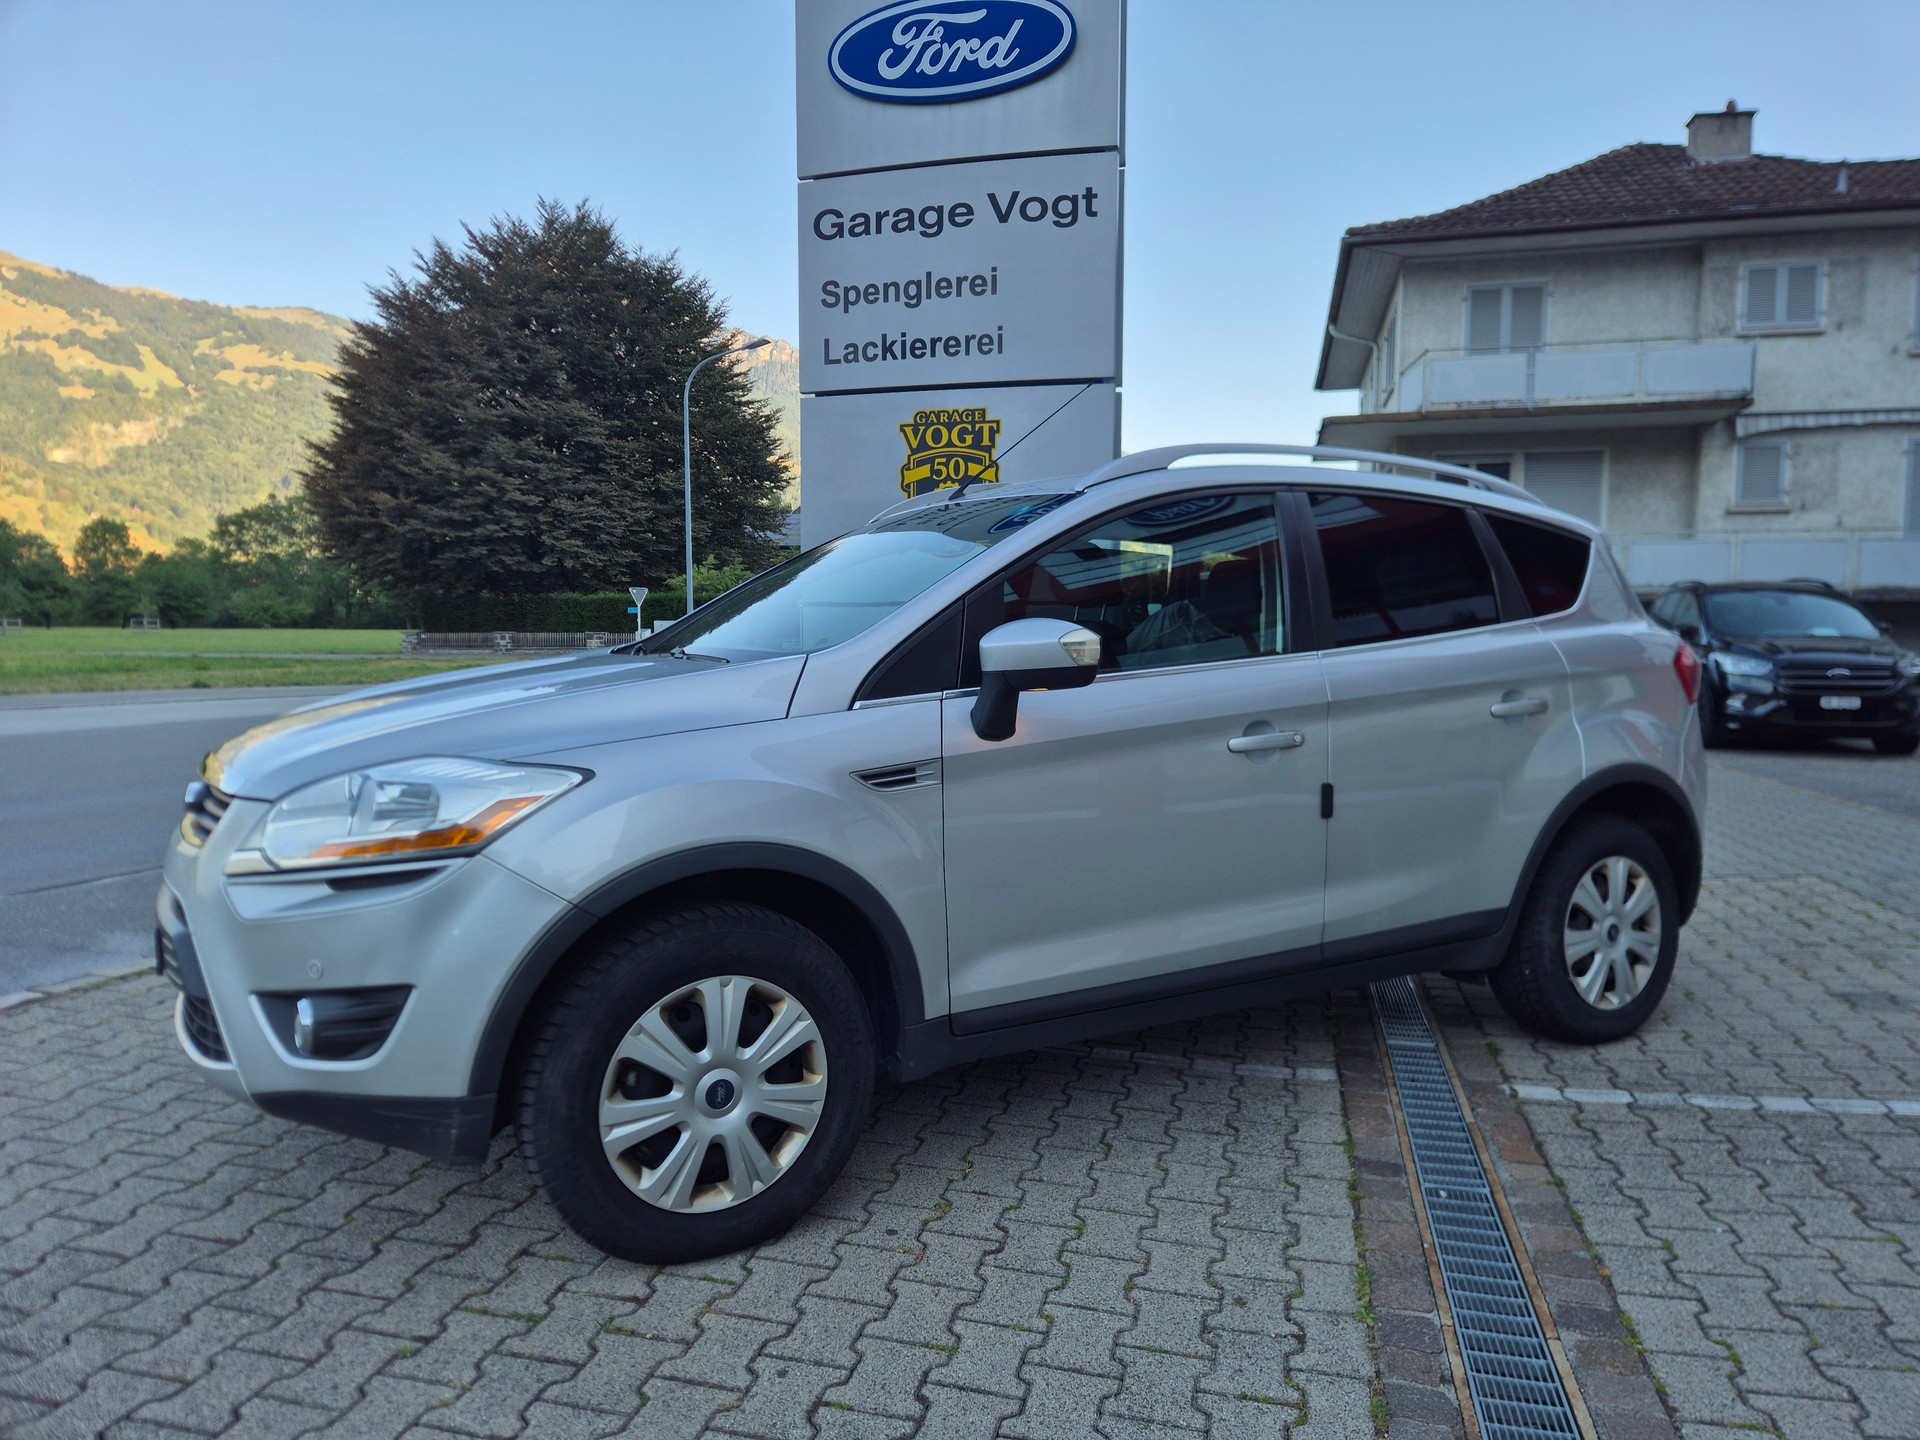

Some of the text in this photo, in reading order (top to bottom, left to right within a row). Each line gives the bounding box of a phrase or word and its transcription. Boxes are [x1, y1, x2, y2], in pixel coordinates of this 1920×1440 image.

[878, 8, 1024, 80] Ford
[813, 187, 1098, 240] Garage Vogt
[821, 266, 998, 313] Spenglerei
[823, 326, 1004, 365] Lackiererei
[903, 423, 997, 449] VOGT
[916, 410, 984, 424] GARAGE
[932, 457, 966, 480] 50
